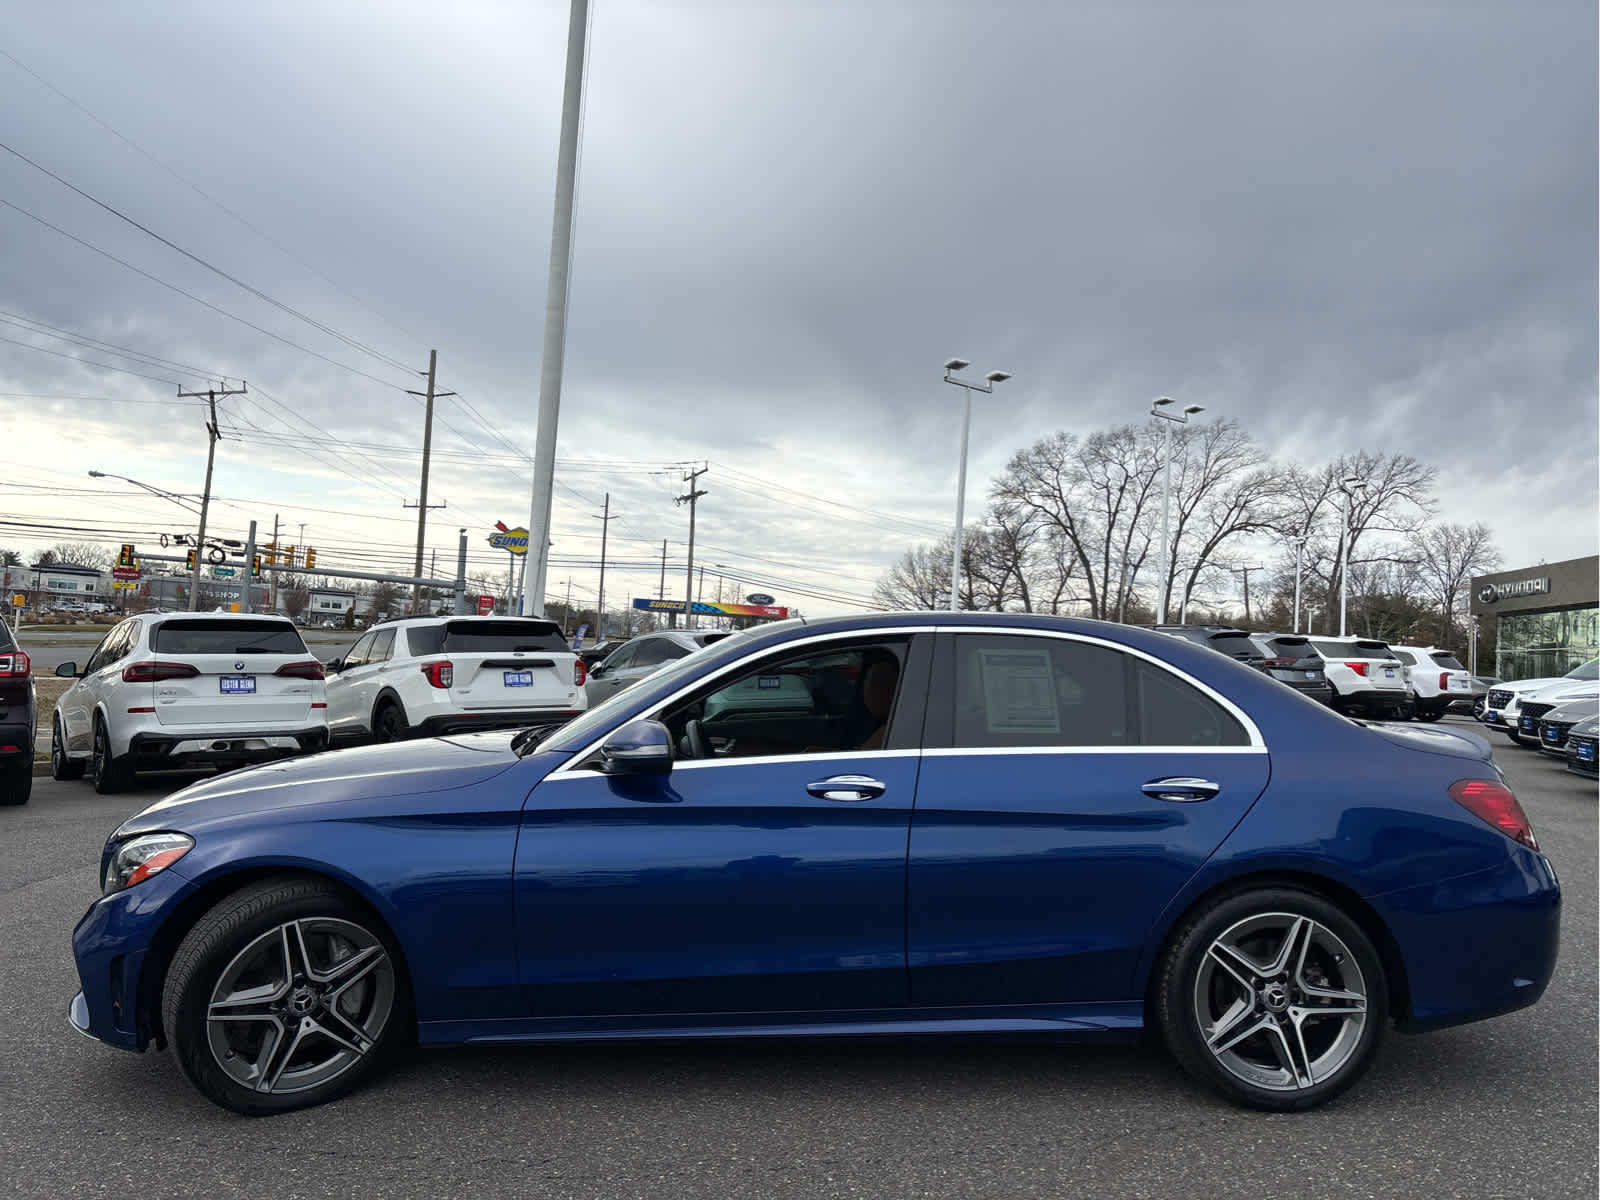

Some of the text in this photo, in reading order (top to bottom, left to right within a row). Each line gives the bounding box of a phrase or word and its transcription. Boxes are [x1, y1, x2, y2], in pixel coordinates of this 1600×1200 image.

[494, 535, 529, 547] SUNO
[1497, 577, 1548, 596] HYUNDAI
[648, 601, 686, 609] SUNOCO
[221, 679, 239, 689] LESTER
